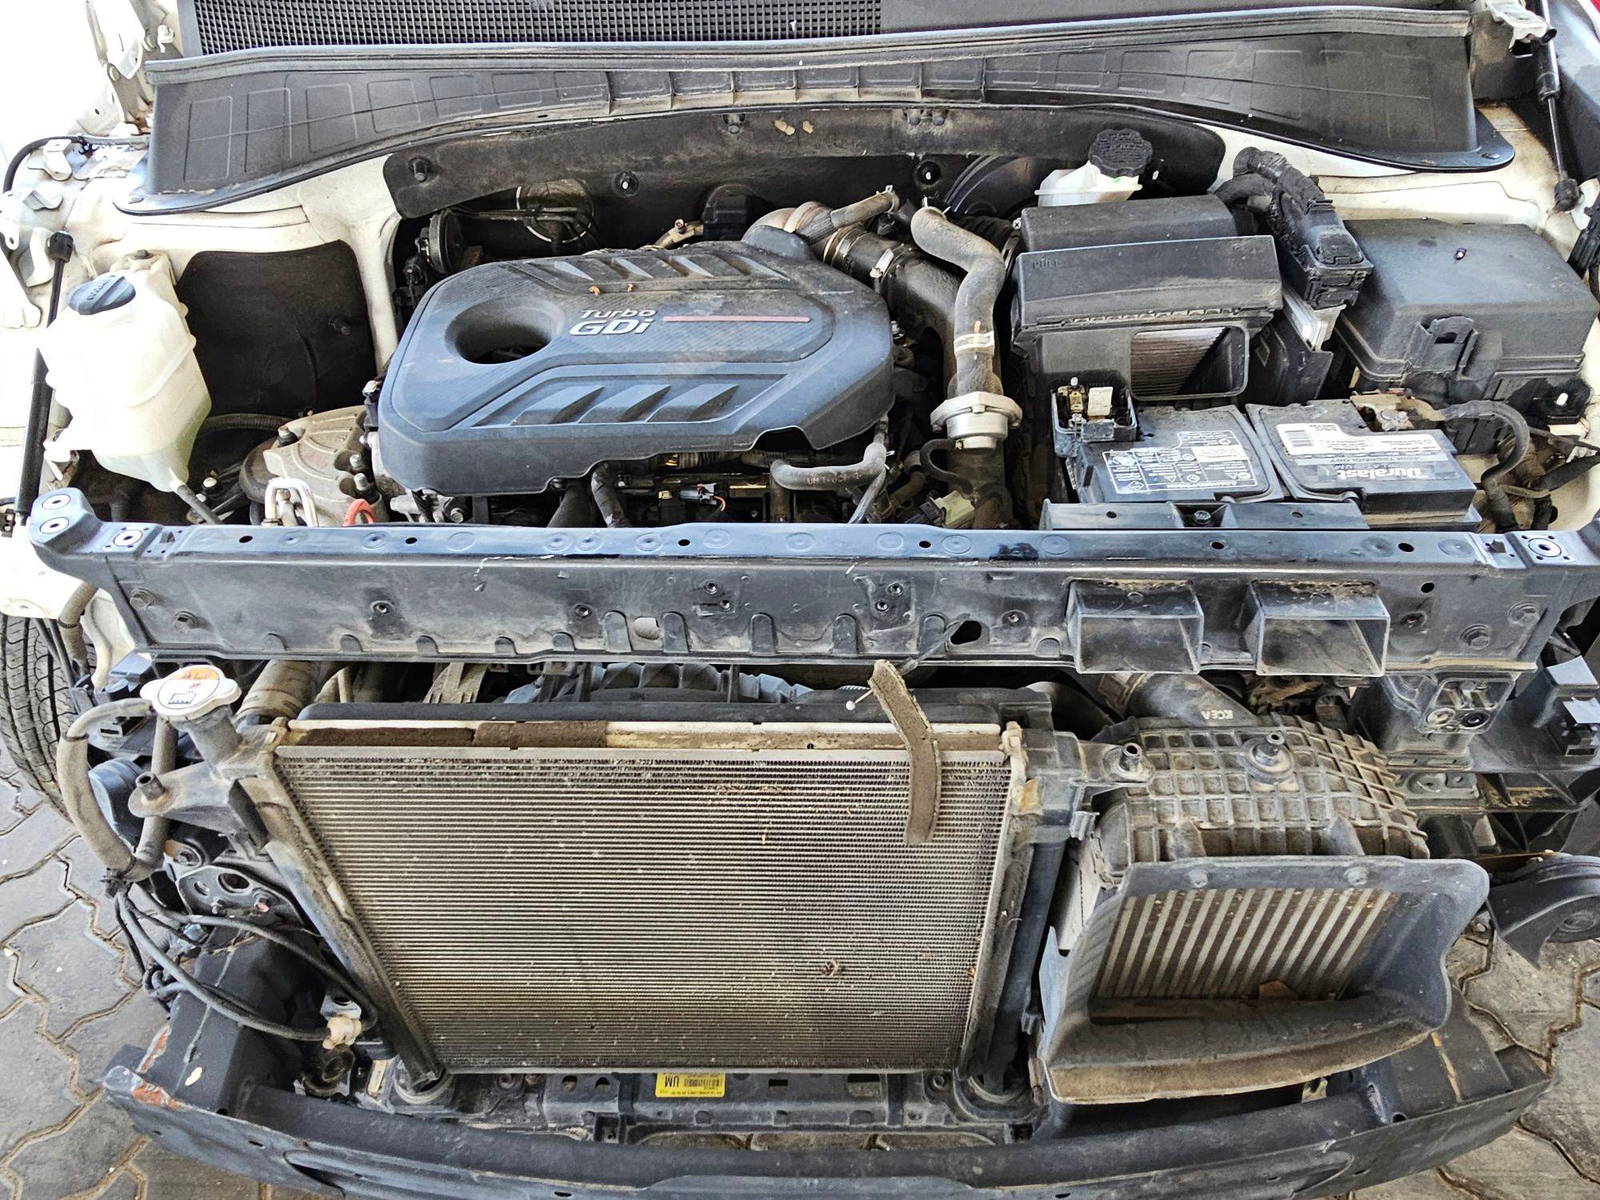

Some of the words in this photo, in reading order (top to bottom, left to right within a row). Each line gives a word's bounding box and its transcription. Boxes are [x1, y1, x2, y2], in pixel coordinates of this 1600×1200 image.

[581, 308, 657, 319] Turbo
[569, 318, 655, 336] GDi
[1336, 467, 1425, 480] Duralast
[664, 1075, 680, 1087] UM
